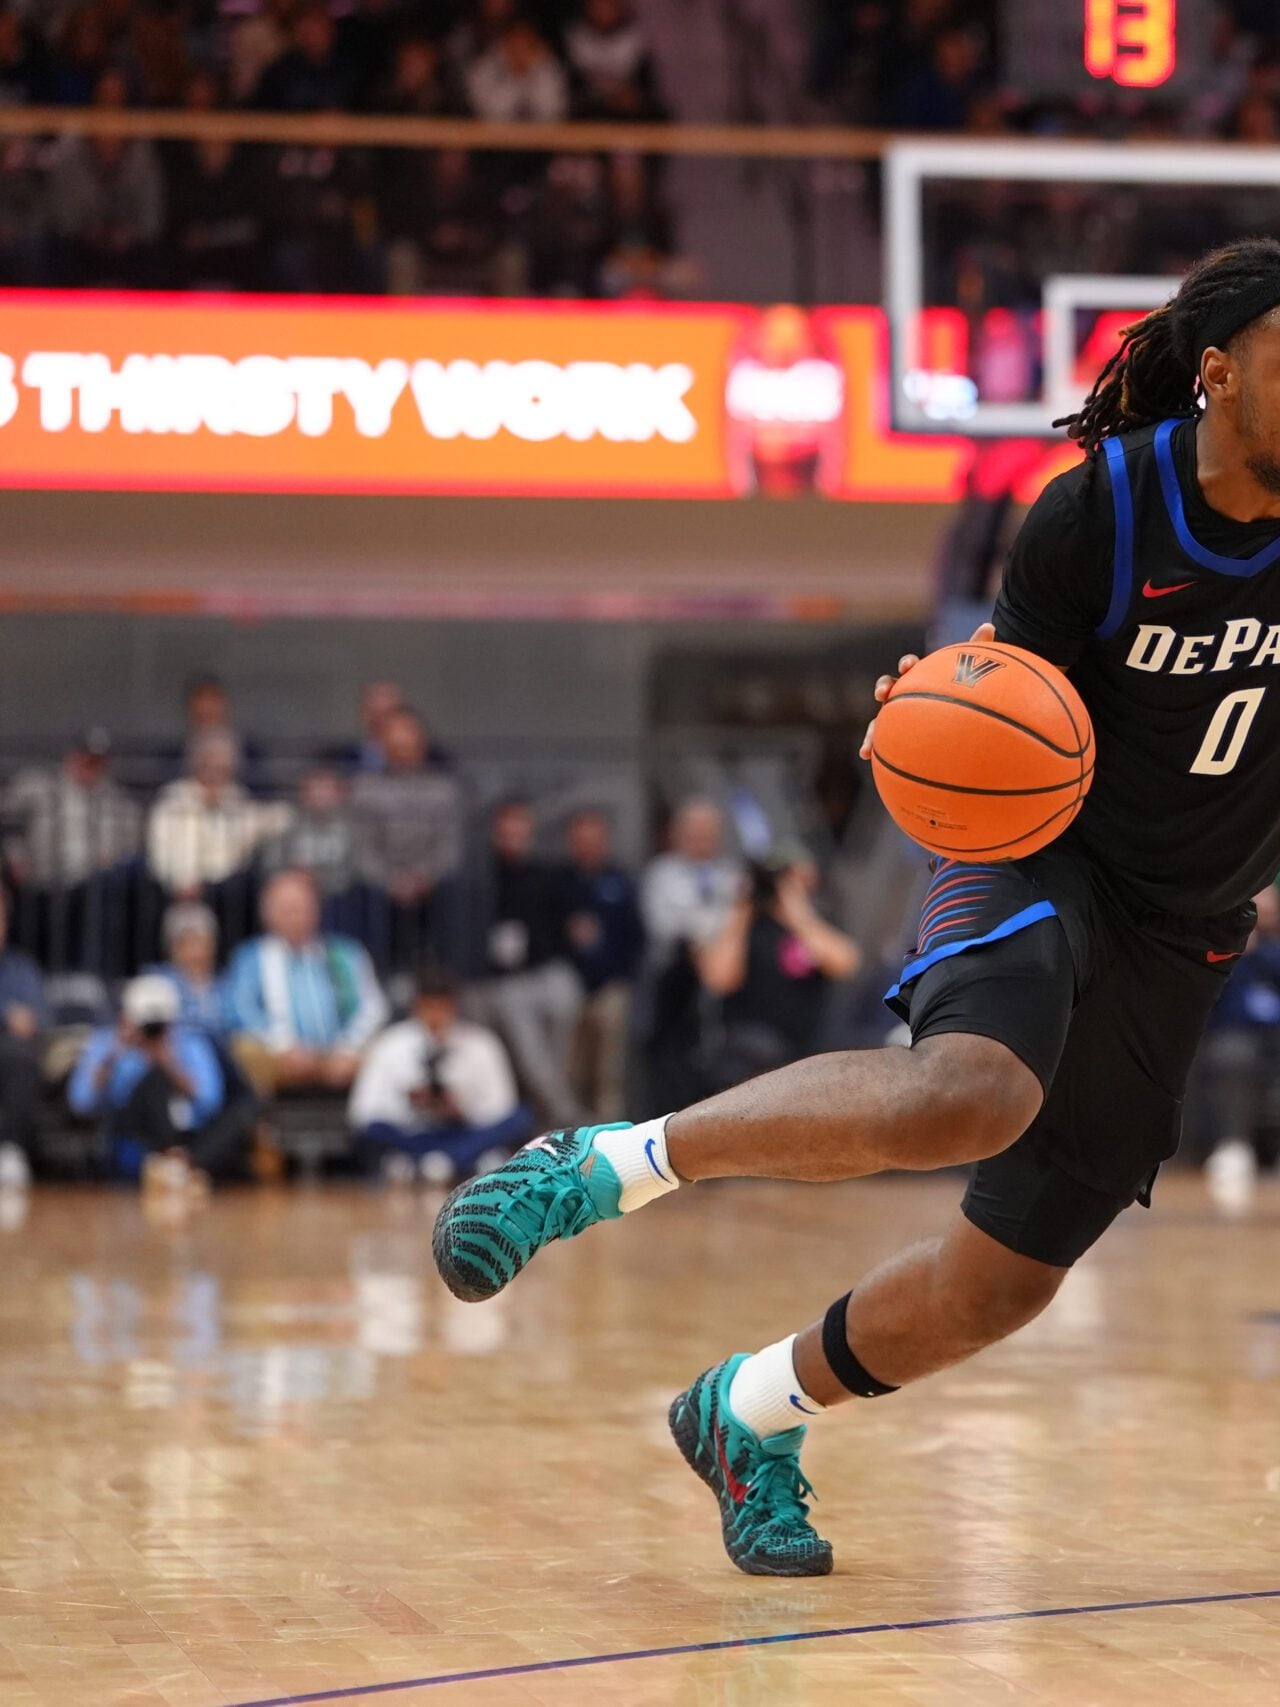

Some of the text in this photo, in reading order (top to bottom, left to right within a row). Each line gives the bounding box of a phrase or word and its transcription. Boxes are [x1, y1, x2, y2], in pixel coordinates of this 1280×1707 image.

[1083, 0, 1175, 87] 13
[22, 351, 408, 437] THIRSTY
[409, 360, 696, 442] WORK
[1189, 687, 1266, 776] 0
